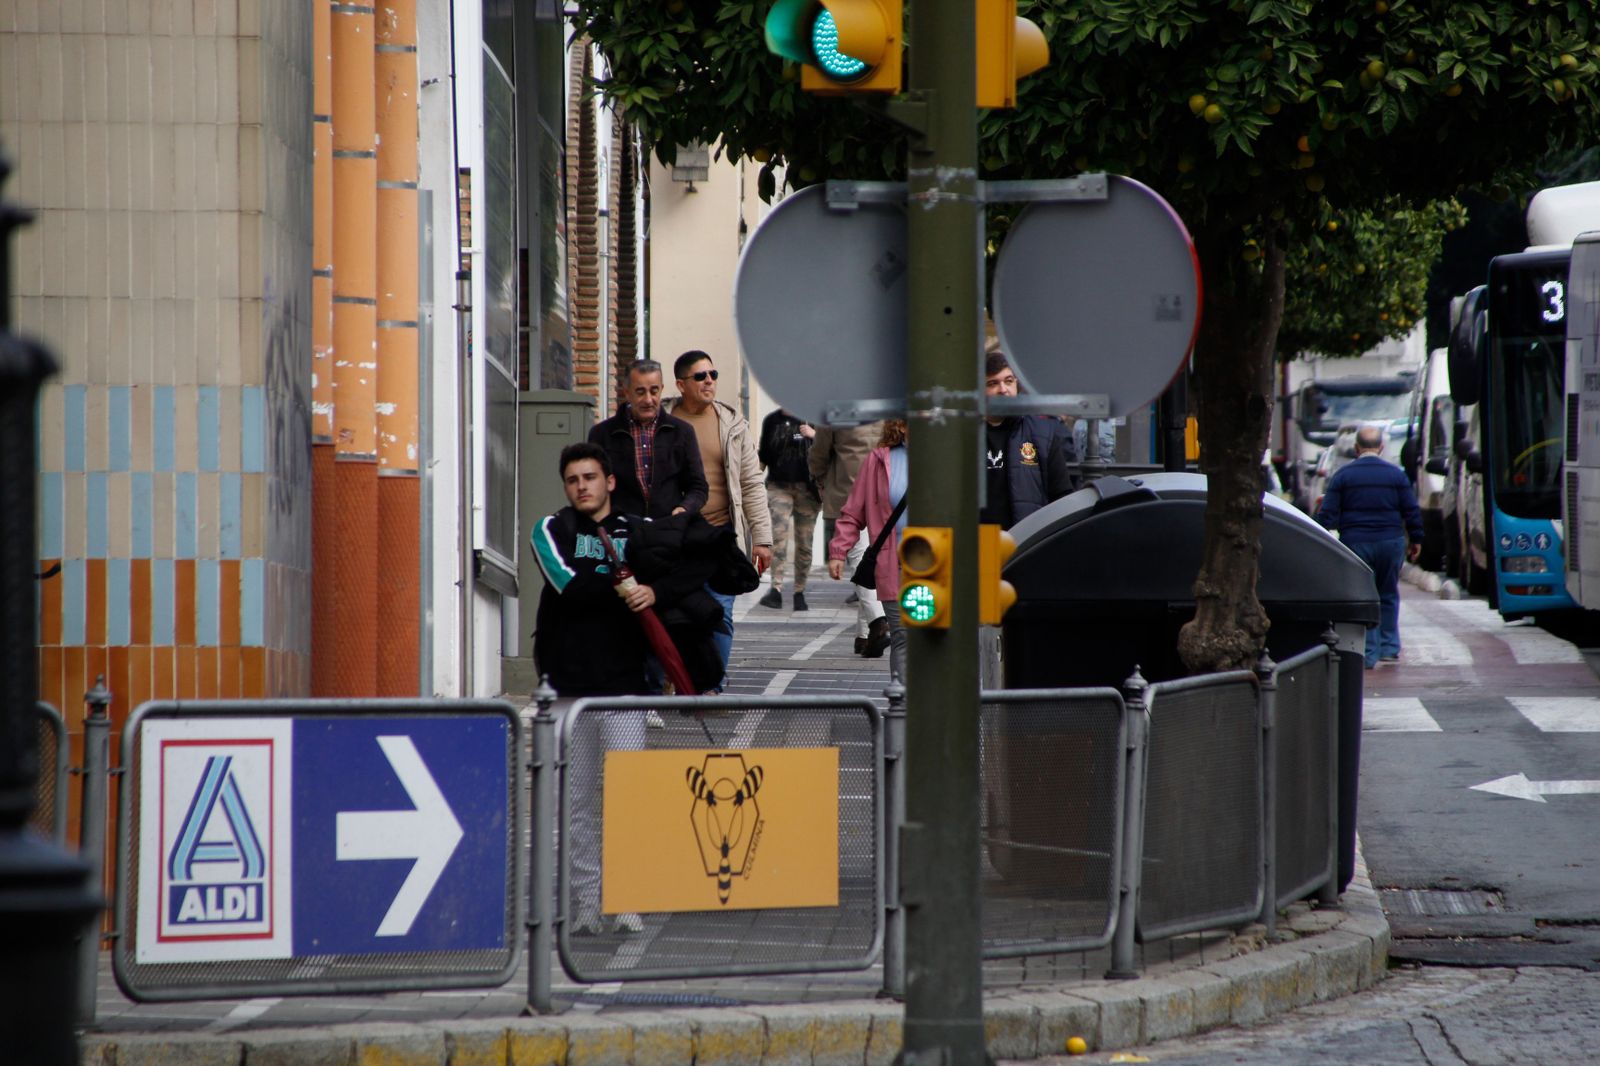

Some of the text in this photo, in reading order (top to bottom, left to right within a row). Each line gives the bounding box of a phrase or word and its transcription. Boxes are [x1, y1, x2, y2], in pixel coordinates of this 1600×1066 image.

[1542, 280, 1565, 322] 3
[575, 533, 628, 562] BOSN
[176, 885, 257, 922] ALDI
